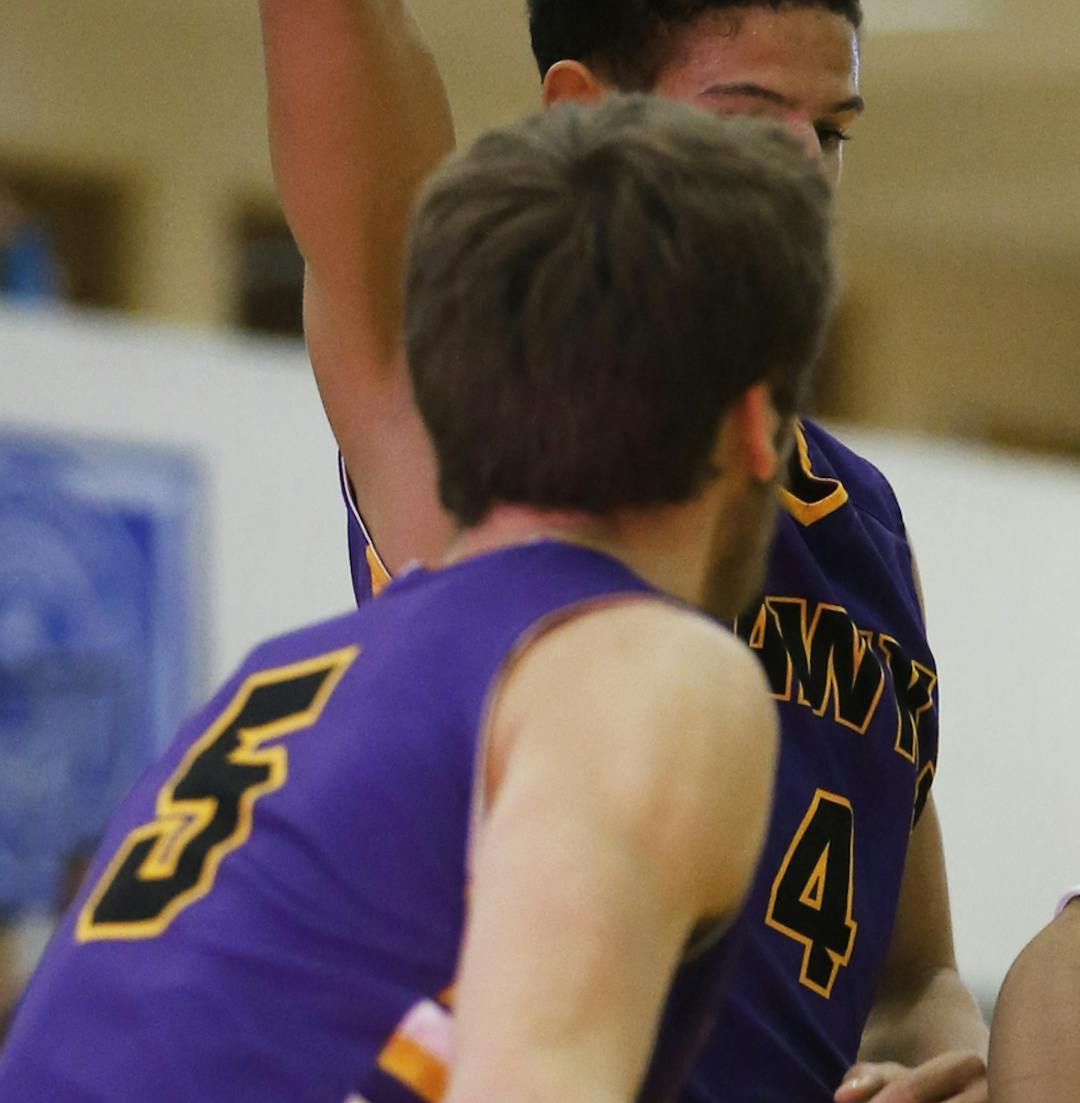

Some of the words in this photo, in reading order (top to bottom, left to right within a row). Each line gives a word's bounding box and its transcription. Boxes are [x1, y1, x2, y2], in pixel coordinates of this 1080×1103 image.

[75, 645, 363, 944] 5
[734, 597, 938, 830] AWK
[765, 788, 857, 999] 4
